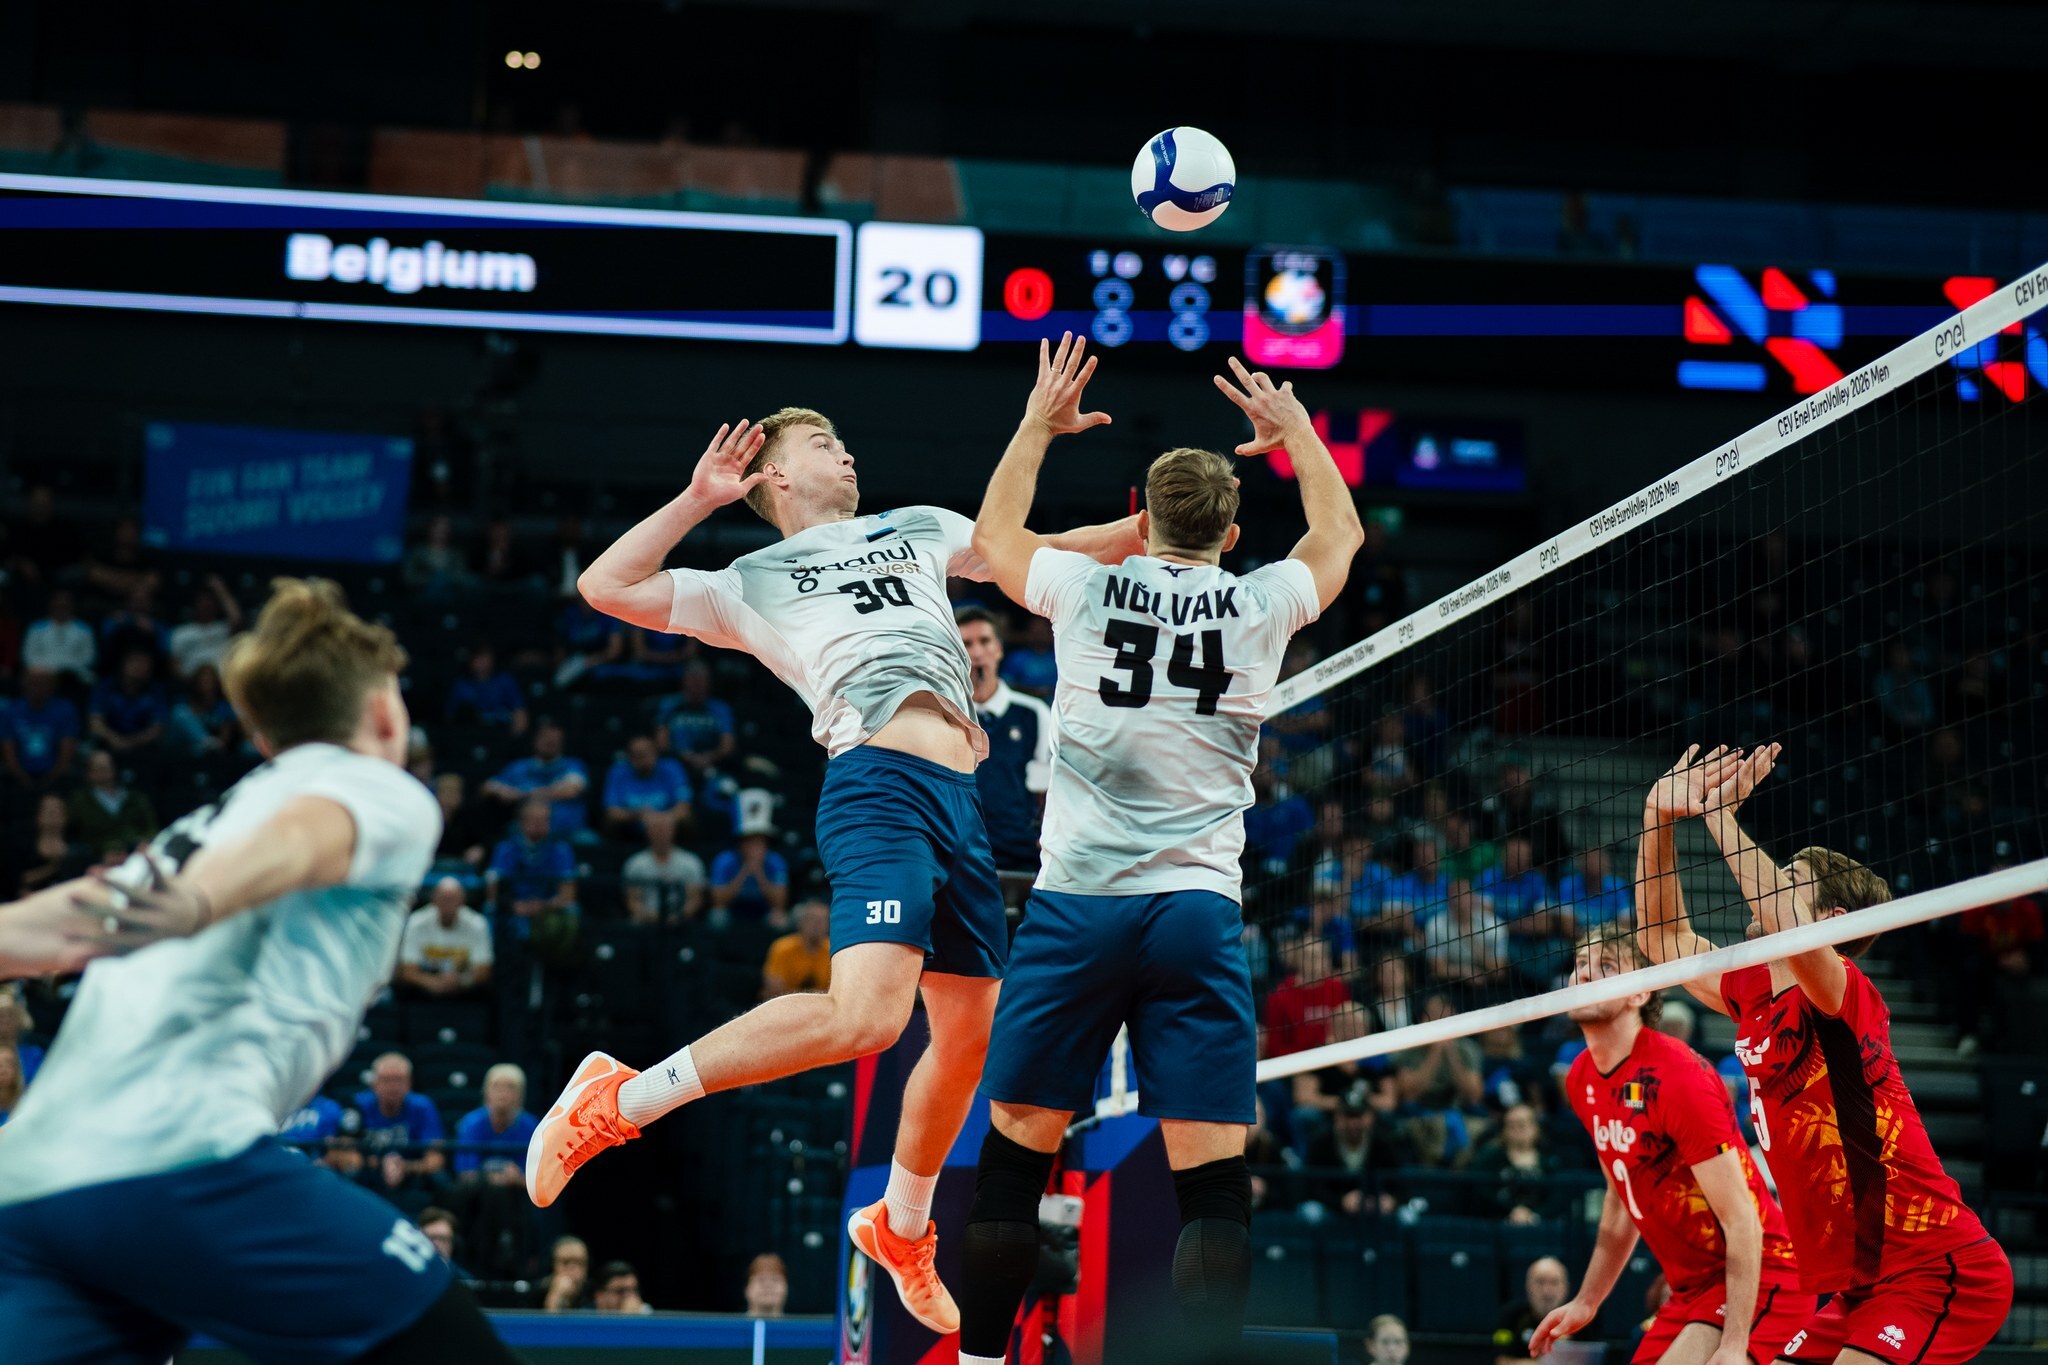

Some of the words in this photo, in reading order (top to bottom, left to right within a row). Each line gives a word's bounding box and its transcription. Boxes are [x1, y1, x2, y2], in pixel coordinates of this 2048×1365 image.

[286, 232, 537, 294] Belgium
[877, 266, 959, 309] 20
[1004, 268, 1054, 321] 0
[2015, 278, 2034, 307] CEV
[1935, 314, 1965, 357] enel
[1777, 413, 1793, 437] CEV
[1794, 402, 1810, 430] Enel
[1810, 385, 1850, 420] EuroVolley
[1850, 371, 1871, 398] 2026
[1871, 365, 1889, 387] Men
[1715, 440, 1740, 477] enel
[1589, 517, 1603, 538] CEV
[1602, 509, 1616, 532] Enel
[1616, 496, 1648, 525] EuroVolley
[1648, 484, 1665, 509] 2026
[1664, 480, 1680, 500] Men
[1539, 538, 1560, 569] enel
[837, 574, 915, 615] 30
[1498, 569, 1512, 587] Men
[1098, 617, 1234, 717] 34
[865, 899, 901, 925] 30
[1783, 1329, 1809, 1356] 5
